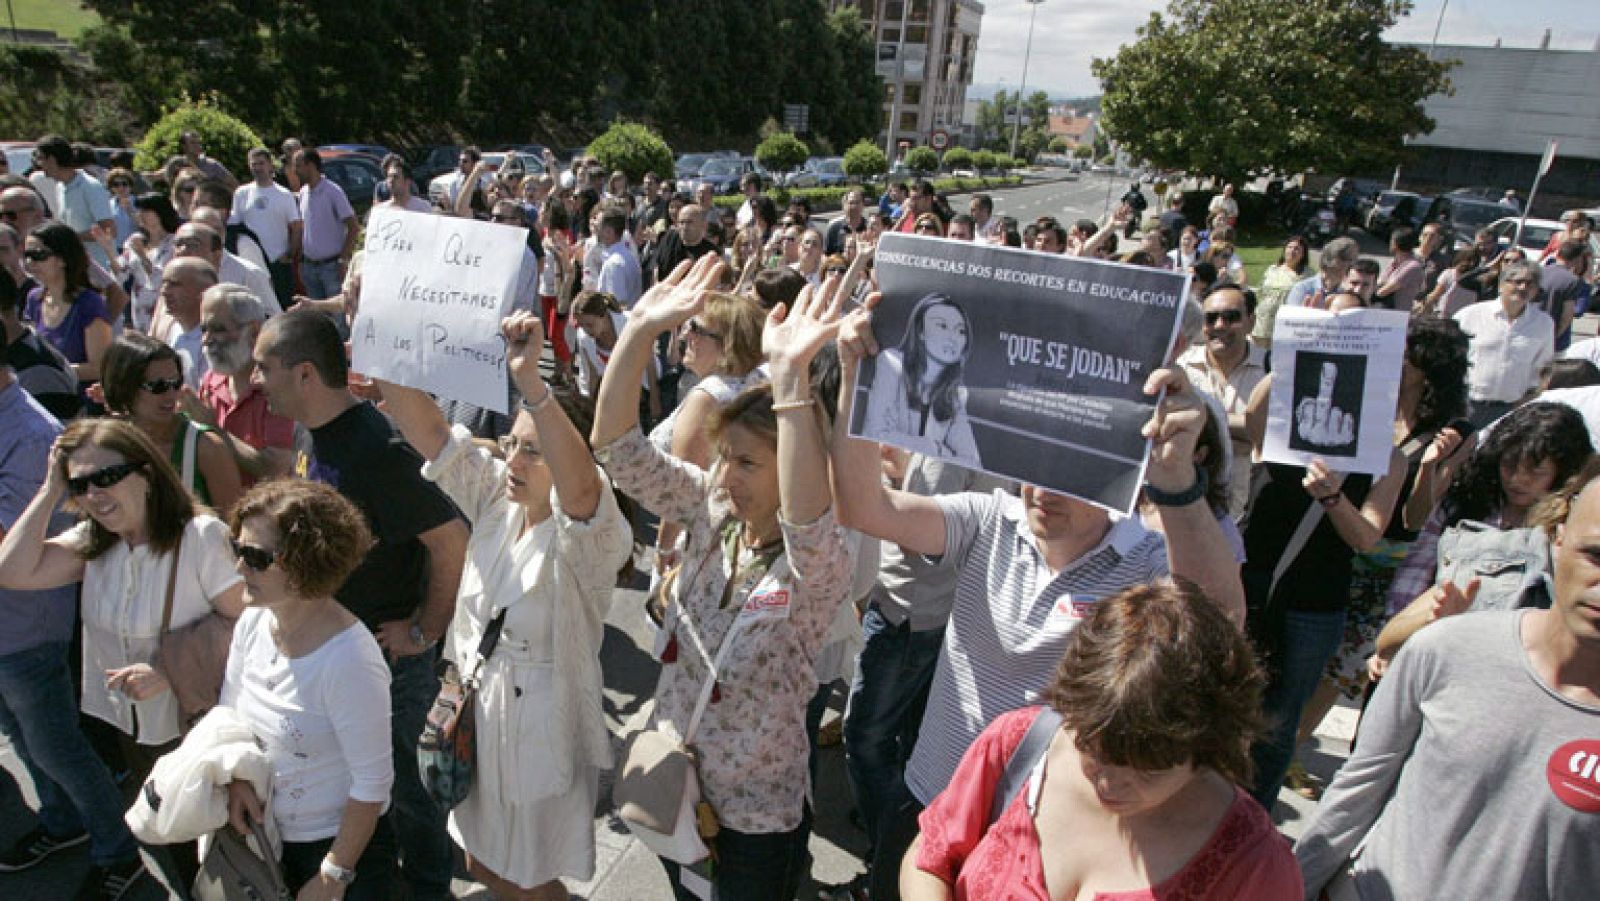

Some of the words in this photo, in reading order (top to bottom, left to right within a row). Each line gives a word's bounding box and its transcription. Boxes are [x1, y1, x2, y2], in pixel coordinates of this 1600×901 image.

[877, 251, 965, 274] CONSECUENCIAS
[966, 262, 992, 279] DOS
[993, 268, 1064, 290] RECORTES
[1067, 279, 1086, 294] EN
[1090, 283, 1178, 309] EDUCACIÓN
[365, 318, 376, 346] A
[1000, 331, 1042, 366] "QUE
[1044, 341, 1069, 370] SE
[1066, 345, 1141, 385] JODAN"
